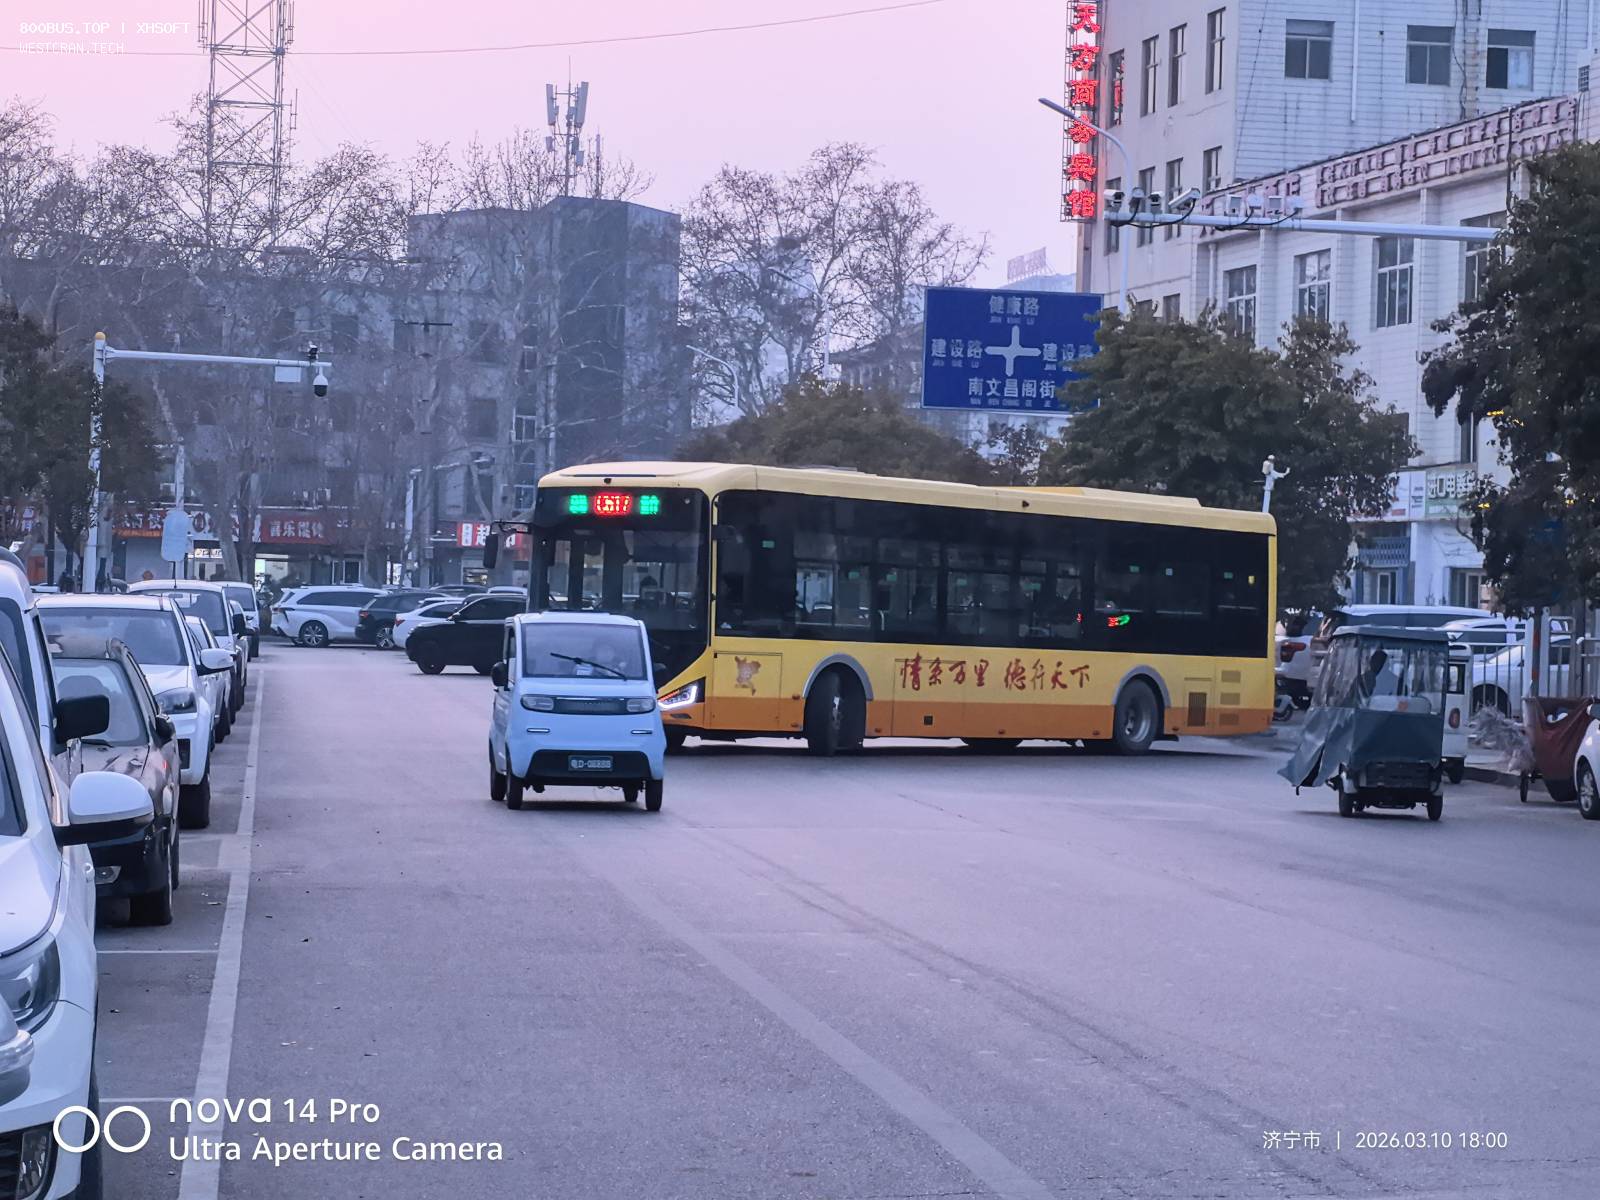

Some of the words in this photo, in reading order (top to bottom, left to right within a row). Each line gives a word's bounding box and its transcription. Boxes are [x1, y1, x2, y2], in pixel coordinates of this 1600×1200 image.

[989, 295, 1039, 316] 健康路
[931, 338, 983, 360] 建设路
[968, 377, 1056, 399] 南文昌阁街
